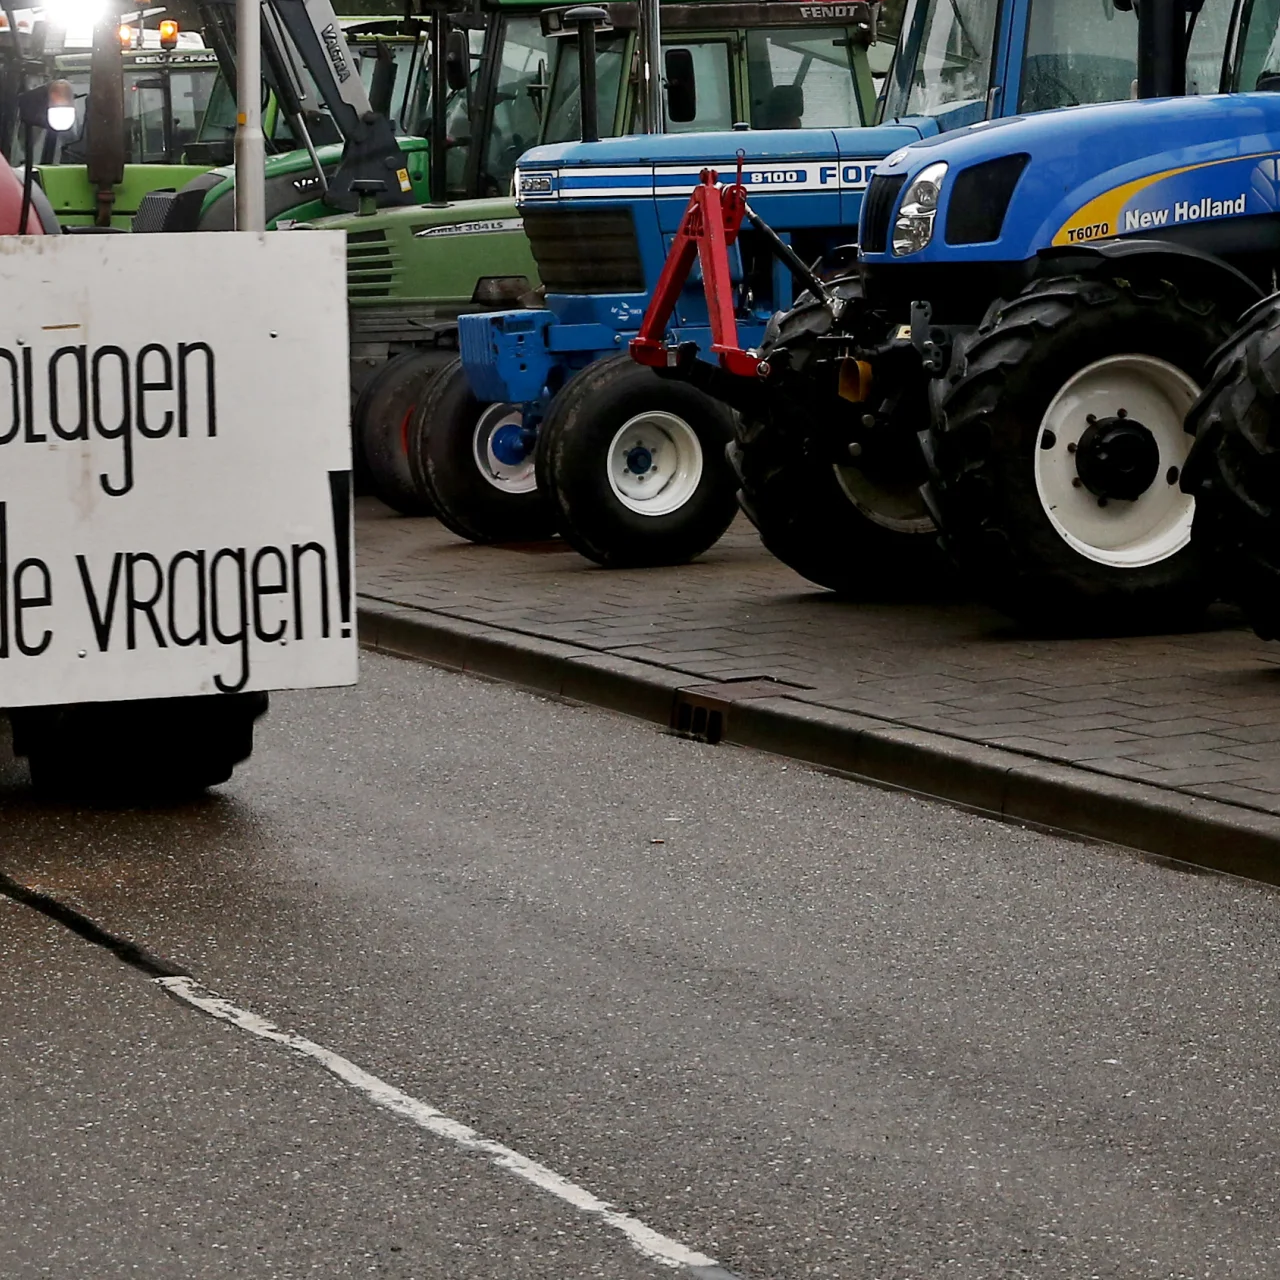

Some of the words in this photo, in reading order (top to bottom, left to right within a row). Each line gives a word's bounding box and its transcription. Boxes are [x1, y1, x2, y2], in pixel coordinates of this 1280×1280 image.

[800, 5, 859, 18] FENDT
[321, 23, 351, 84] VALTRA
[751, 171, 798, 184] 8100
[1125, 208, 1169, 231] New
[1174, 193, 1246, 222] Holland
[466, 222, 489, 232] 304
[1067, 222, 1109, 242] T6070
